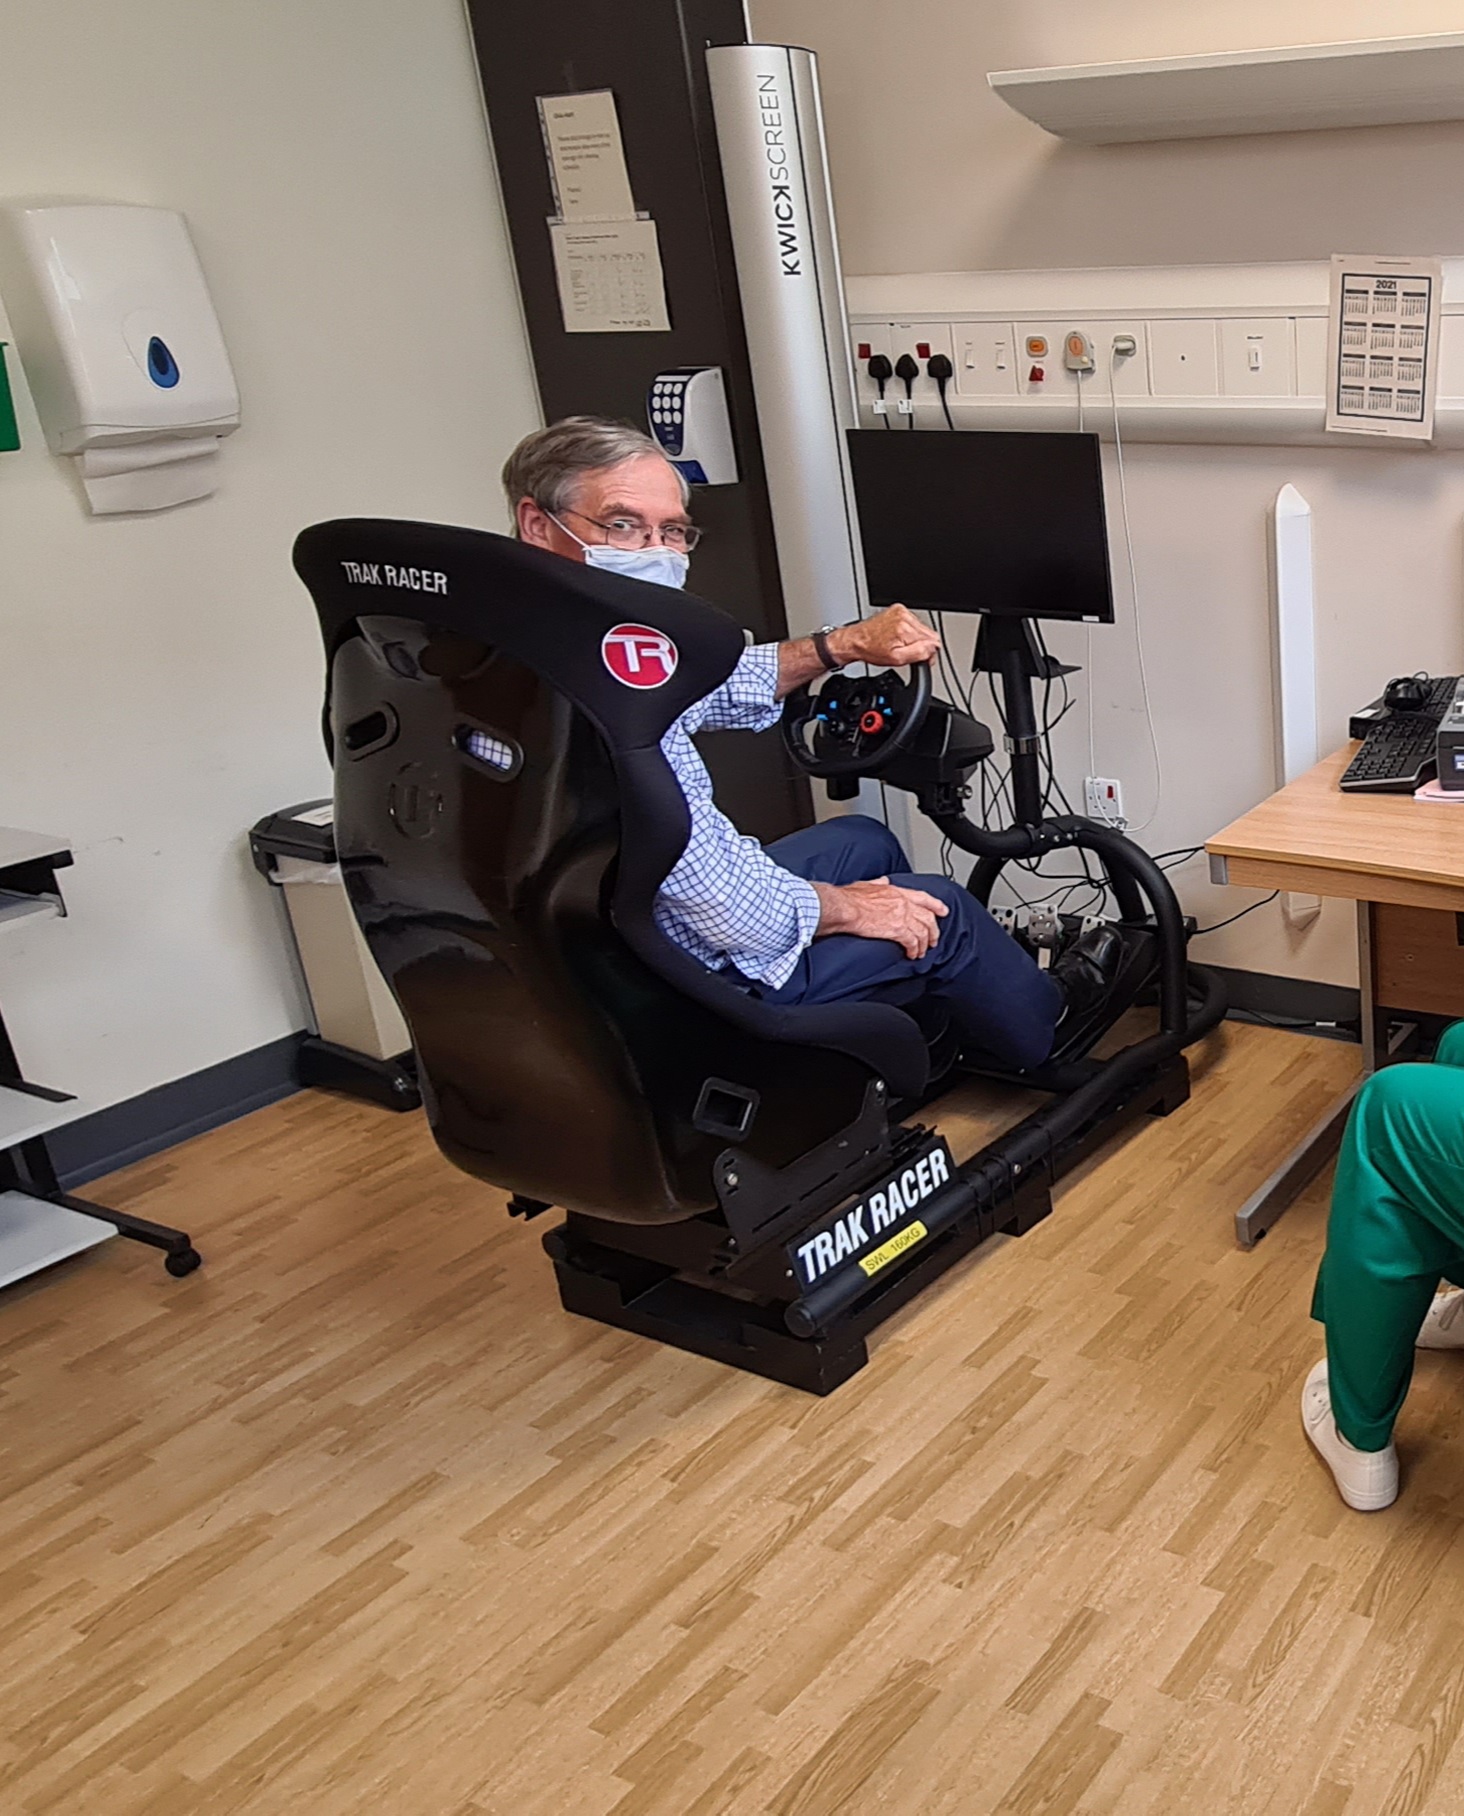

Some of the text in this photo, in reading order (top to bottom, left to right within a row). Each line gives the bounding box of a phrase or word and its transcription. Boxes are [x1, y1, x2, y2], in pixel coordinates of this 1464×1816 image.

[1375, 279, 1397, 290] 2021
[340, 561, 448, 596] TRAK RACER
[797, 1148, 949, 1283] TRAK RACER
[865, 1227, 921, 1271] SWL 160KG
